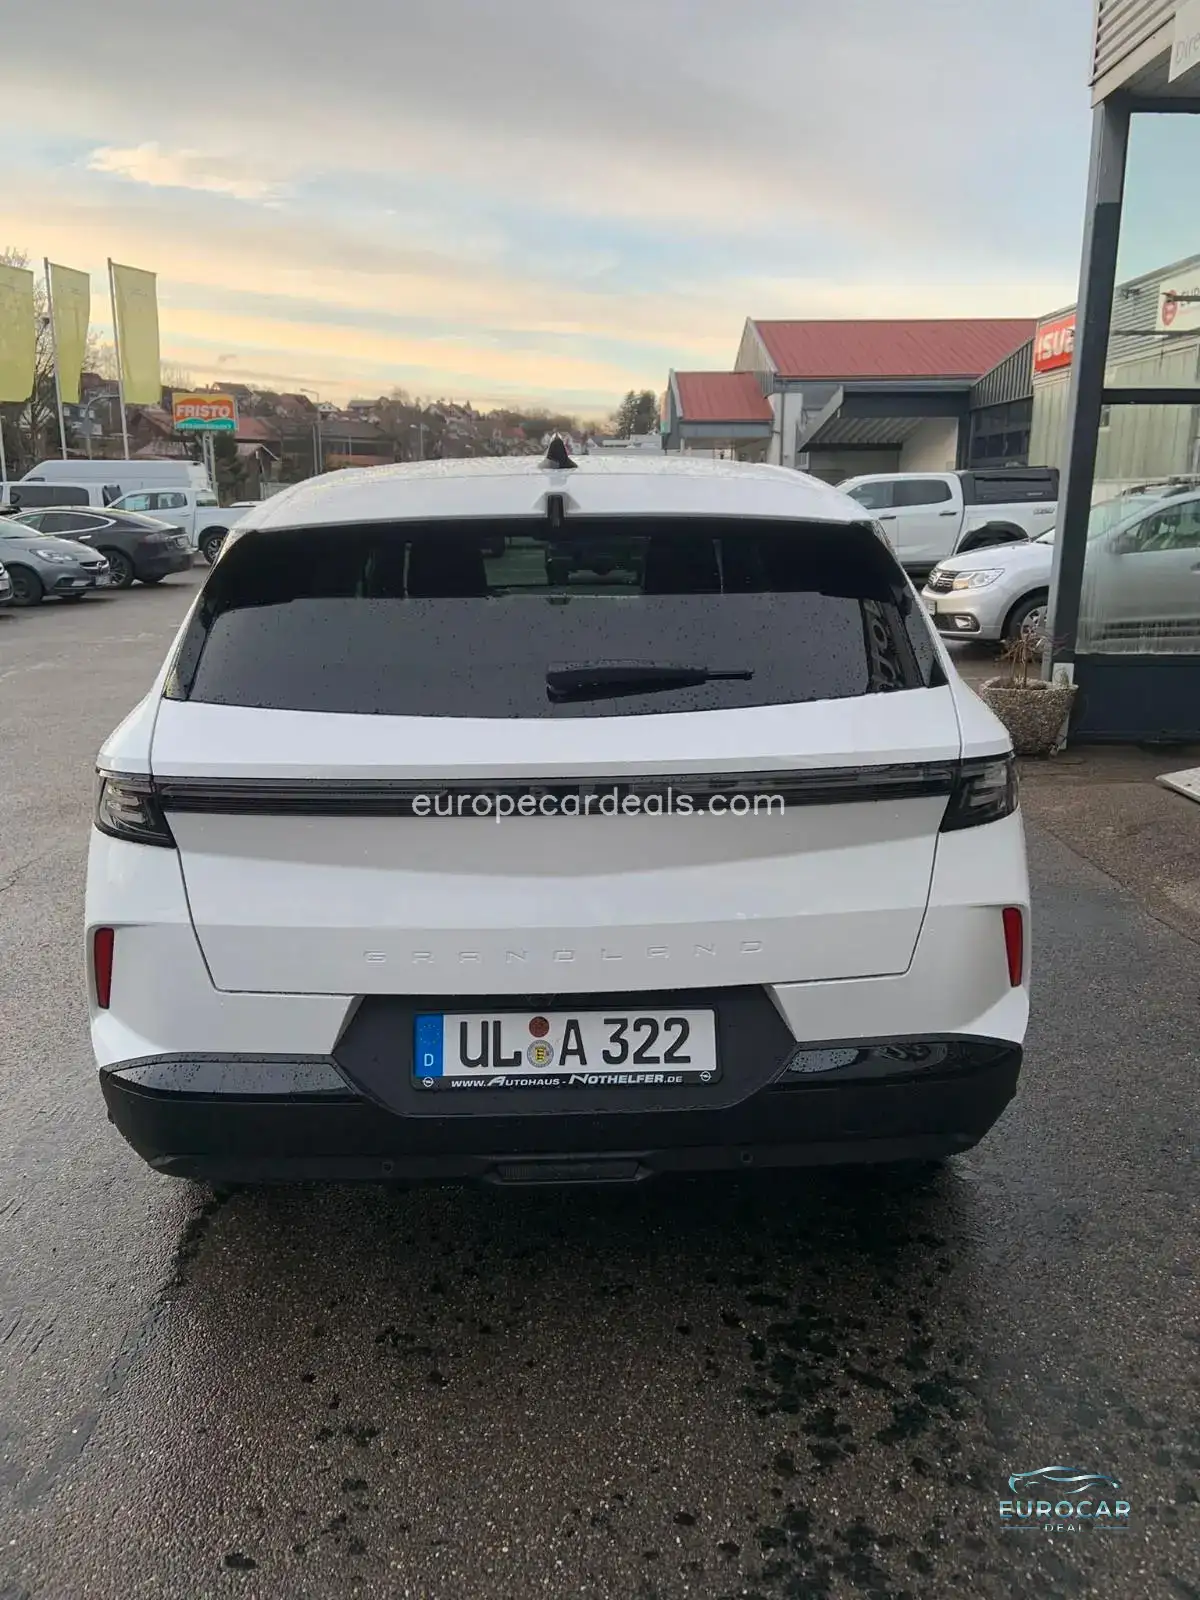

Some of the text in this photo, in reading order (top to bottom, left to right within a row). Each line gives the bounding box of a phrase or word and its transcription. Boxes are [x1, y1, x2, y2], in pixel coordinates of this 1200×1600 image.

[176, 404, 231, 417] FRISTO
[362, 939, 765, 965] GRANDLAND
[459, 1017, 692, 1068] UL A 322
[423, 1053, 434, 1067] D
